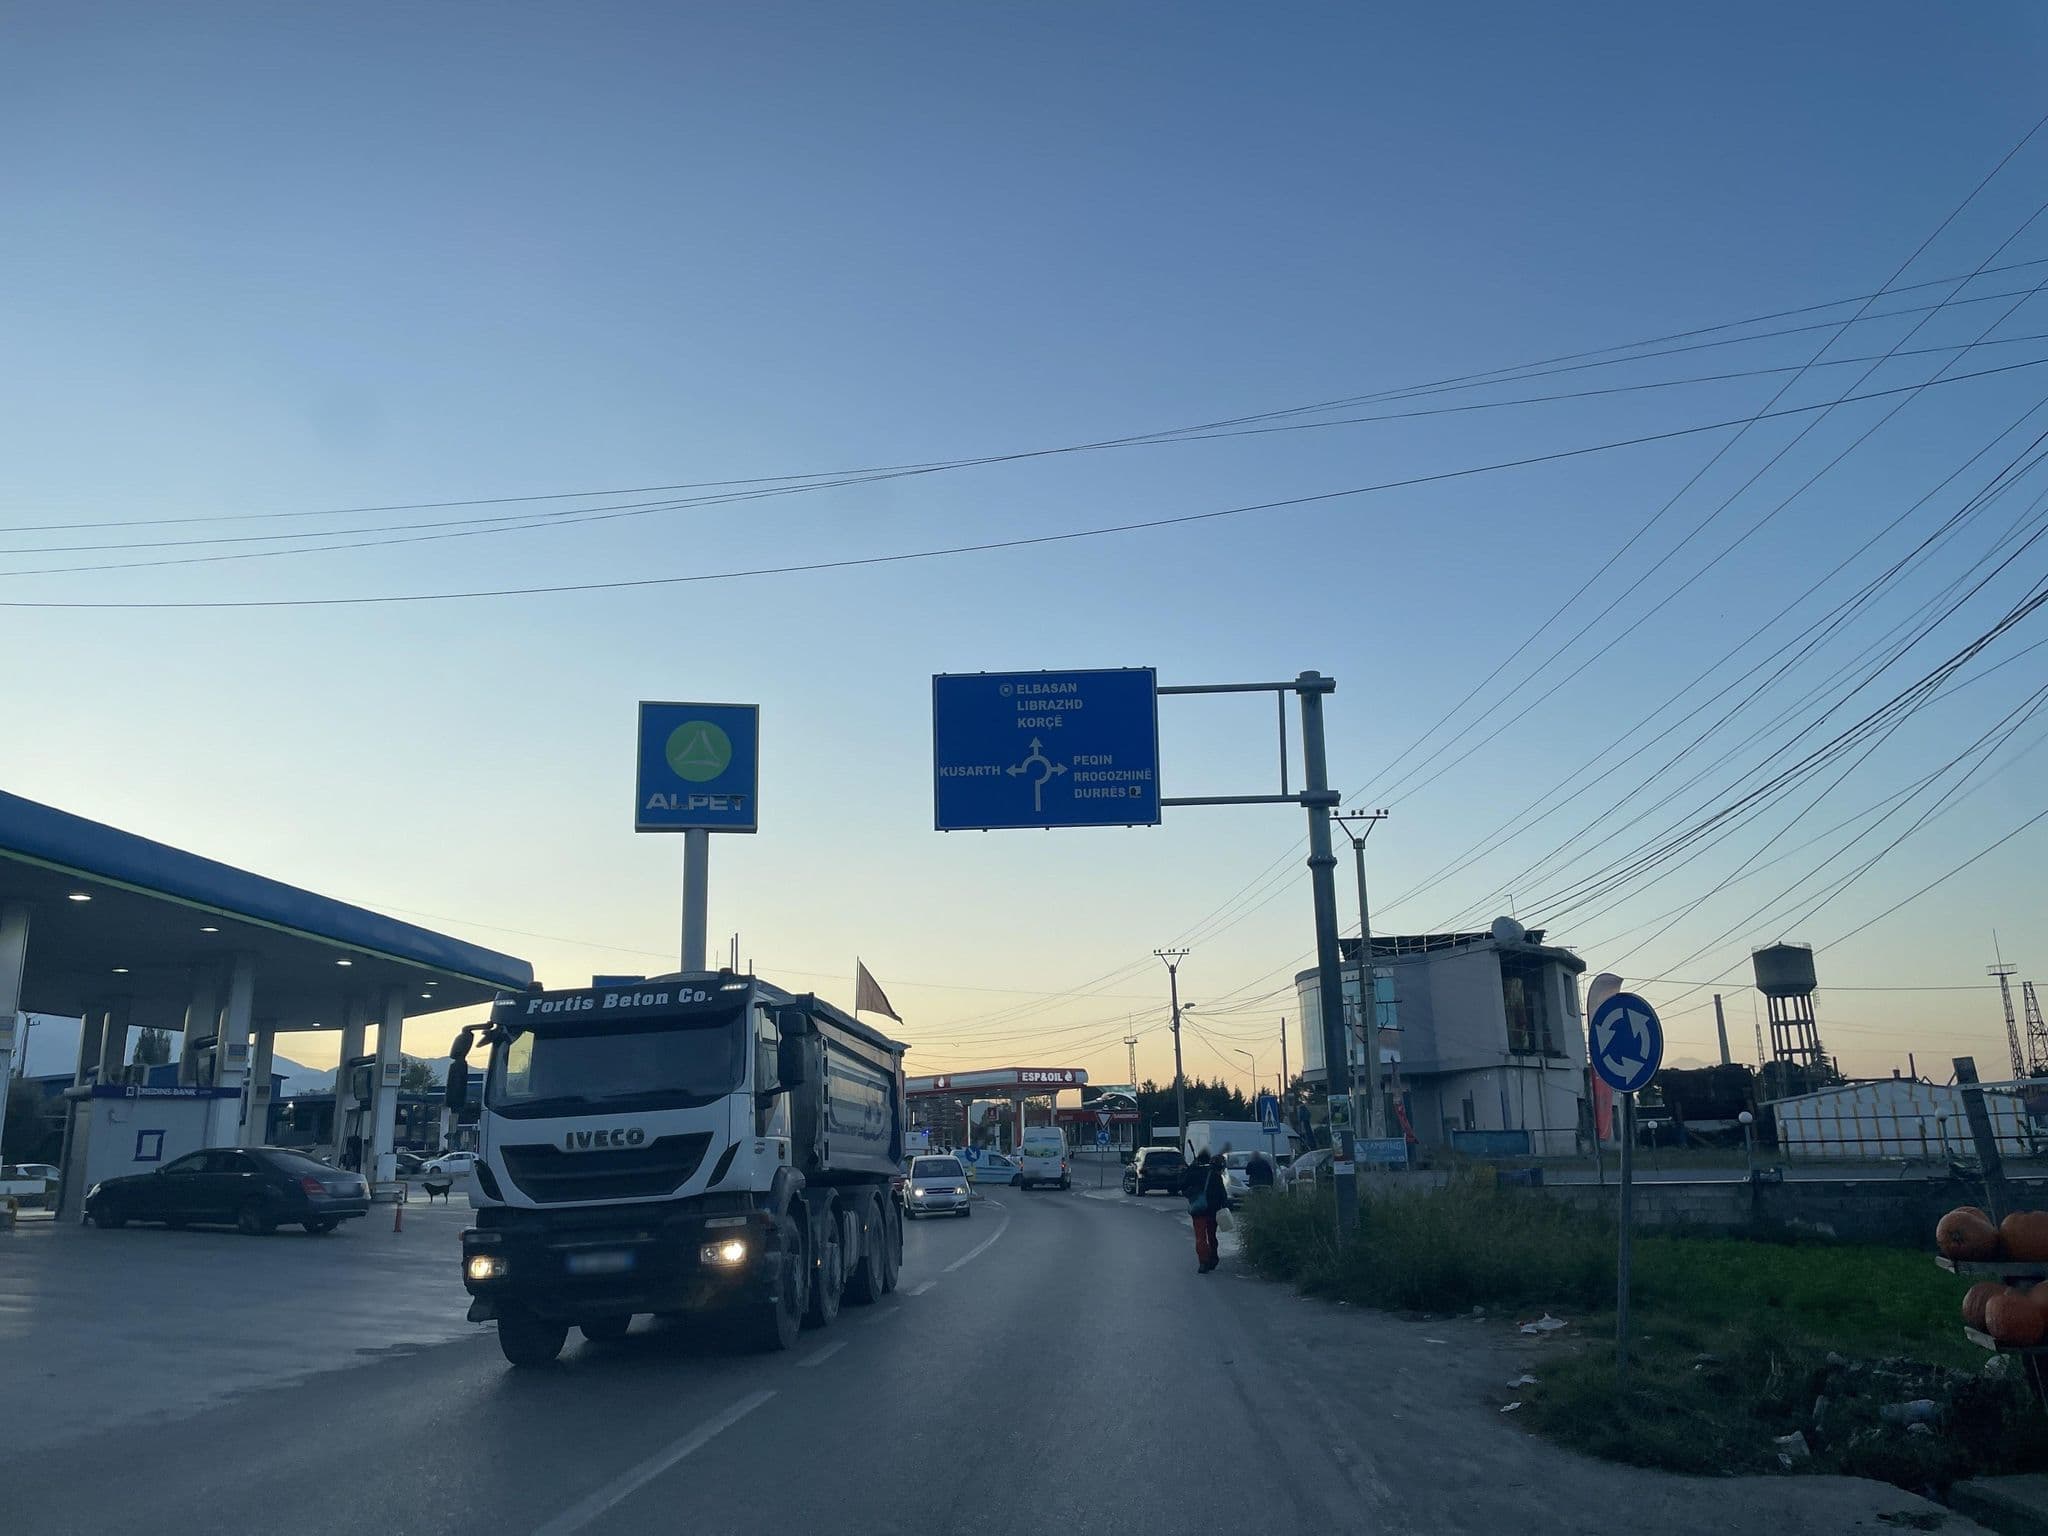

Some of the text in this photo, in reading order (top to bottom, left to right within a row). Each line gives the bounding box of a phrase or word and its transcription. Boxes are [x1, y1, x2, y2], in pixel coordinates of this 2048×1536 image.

[1016, 683, 1077, 694] ELBASAN
[1017, 699, 1083, 711] LIBRAZHD
[1017, 715, 1063, 730] KORÇË
[1073, 755, 1112, 766] PEQIN
[940, 765, 1000, 777] KUSARTH
[1074, 769, 1152, 782] RROGOZHINË
[1074, 786, 1126, 799] DURRËS
[526, 988, 713, 1014] Fortis Beton Co.
[1022, 1072, 1063, 1082] ESP&OIL
[566, 1127, 645, 1150] IVECO
